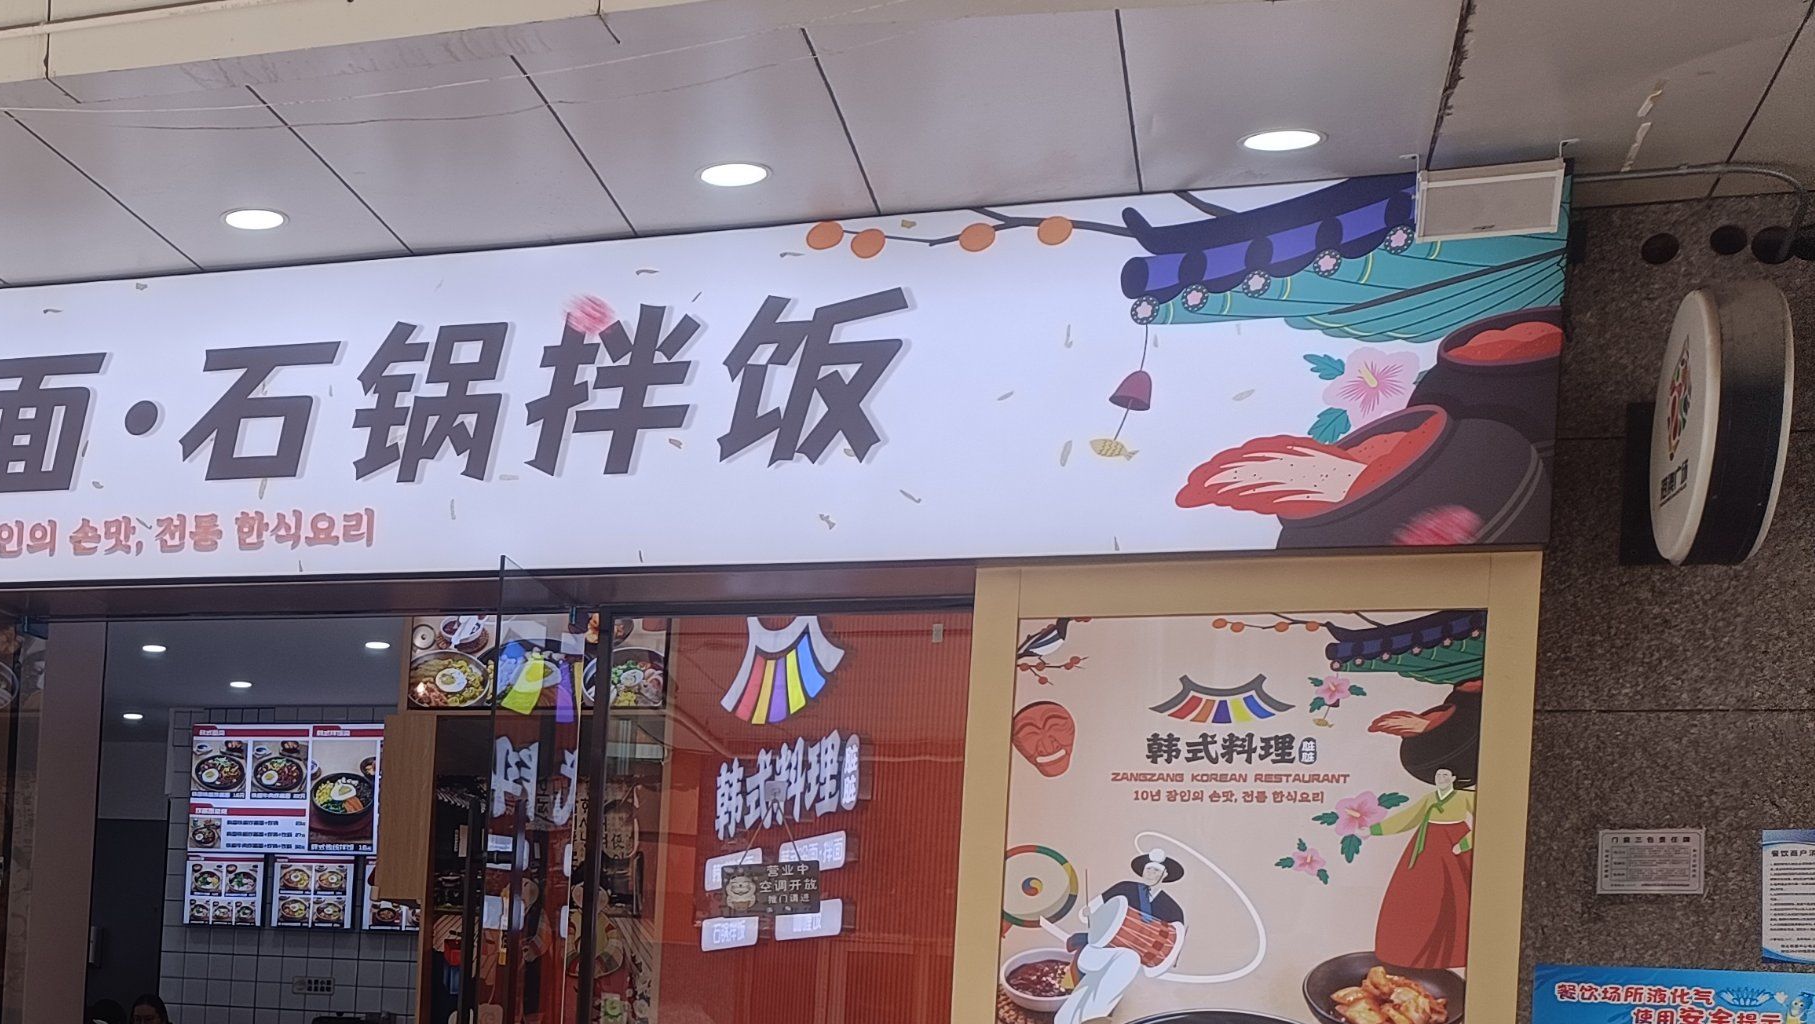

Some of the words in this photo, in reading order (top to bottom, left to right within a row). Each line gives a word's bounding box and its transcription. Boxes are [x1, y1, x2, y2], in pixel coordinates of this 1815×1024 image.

[69, 516, 144, 557] 손맛,
[156, 513, 223, 554] 전통
[235, 507, 375, 550] 한식요리
[1146, 732, 1296, 765] 韩式料理
[715, 729, 841, 840] 韩式料理
[1111, 773, 1184, 783] ZANGZANG
[1191, 773, 1248, 783] KOREAN
[1254, 773, 1350, 784] RESTAURANT
[1134, 789, 1161, 801] 10년
[1166, 789, 1204, 802] 장인의
[1209, 790, 1238, 803] 손맛,
[1272, 790, 1324, 803] 한식요리
[766, 863, 810, 877] 营业中
[759, 878, 818, 893] 空调开放
[1557, 983, 1715, 1006] 餐饮场所液化气
